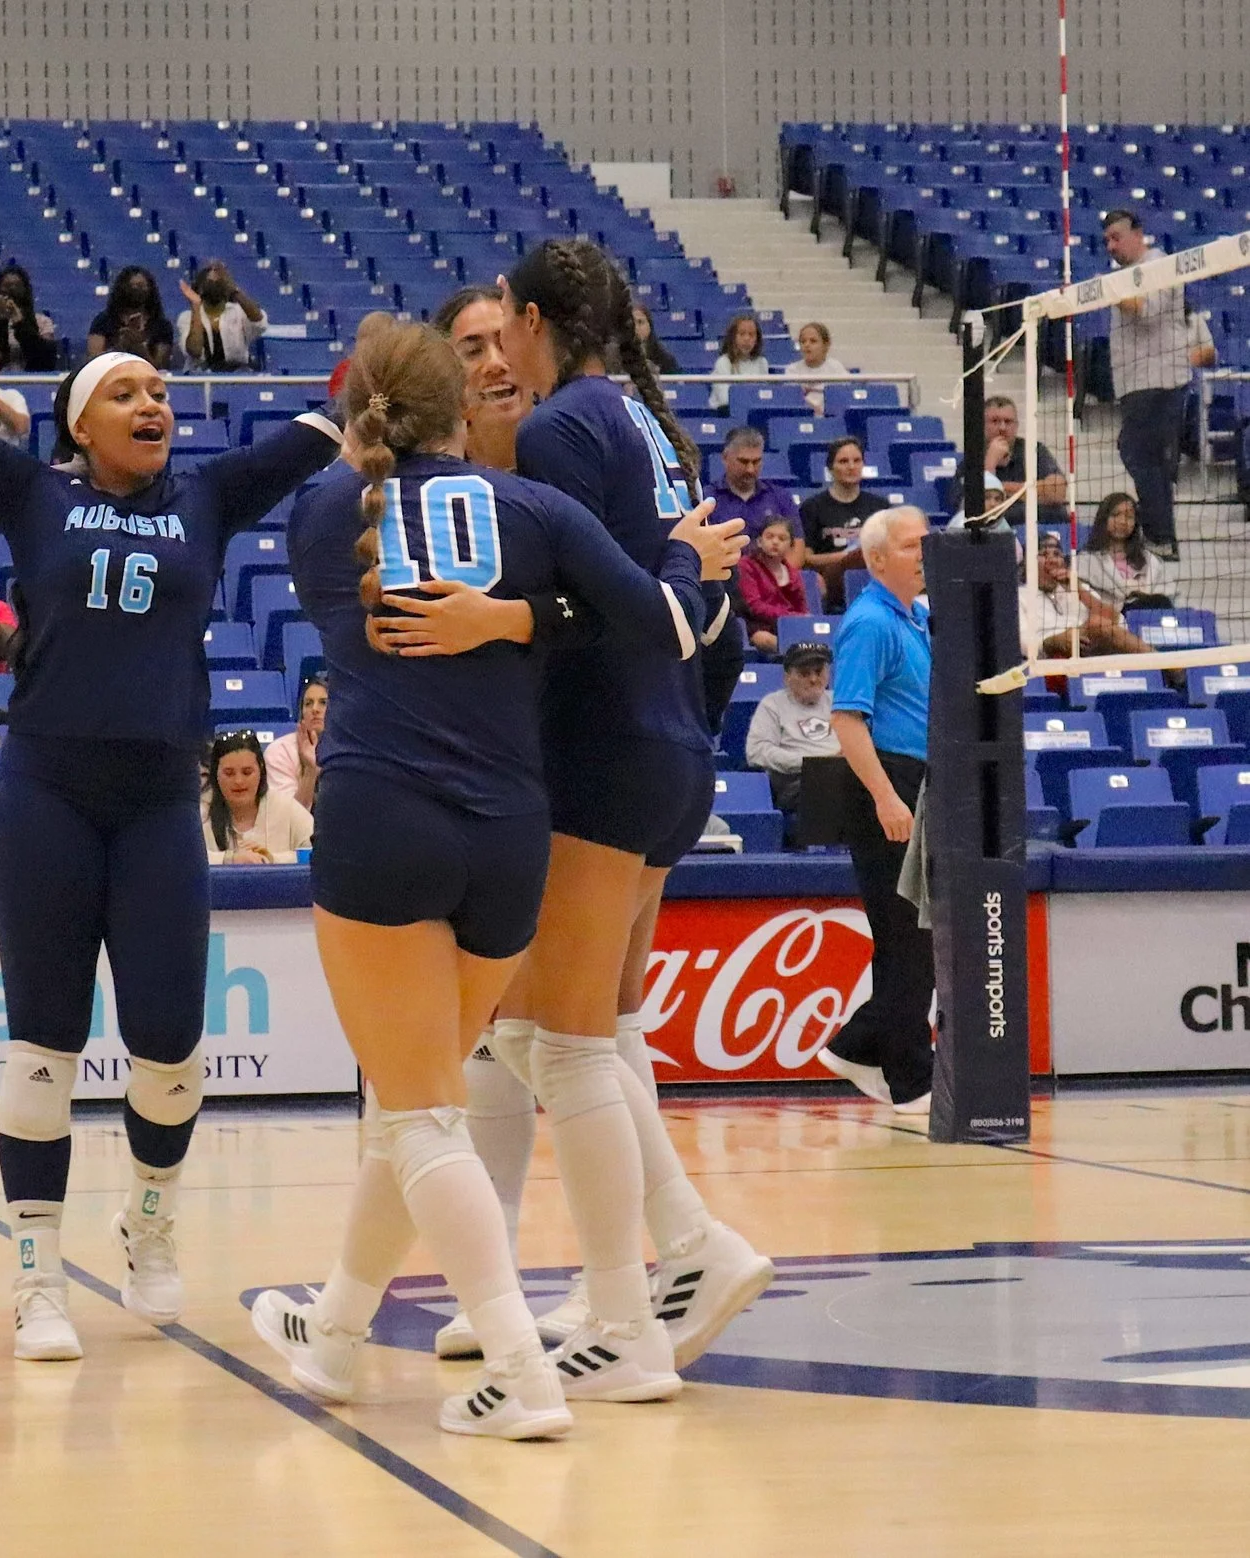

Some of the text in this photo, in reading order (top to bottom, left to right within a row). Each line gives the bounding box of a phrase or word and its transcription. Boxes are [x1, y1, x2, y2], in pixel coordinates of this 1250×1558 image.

[64, 504, 186, 543] AUGUSTA
[362, 475, 502, 592] 10
[86, 548, 159, 614] 16
[983, 891, 1007, 1038] sports imports
